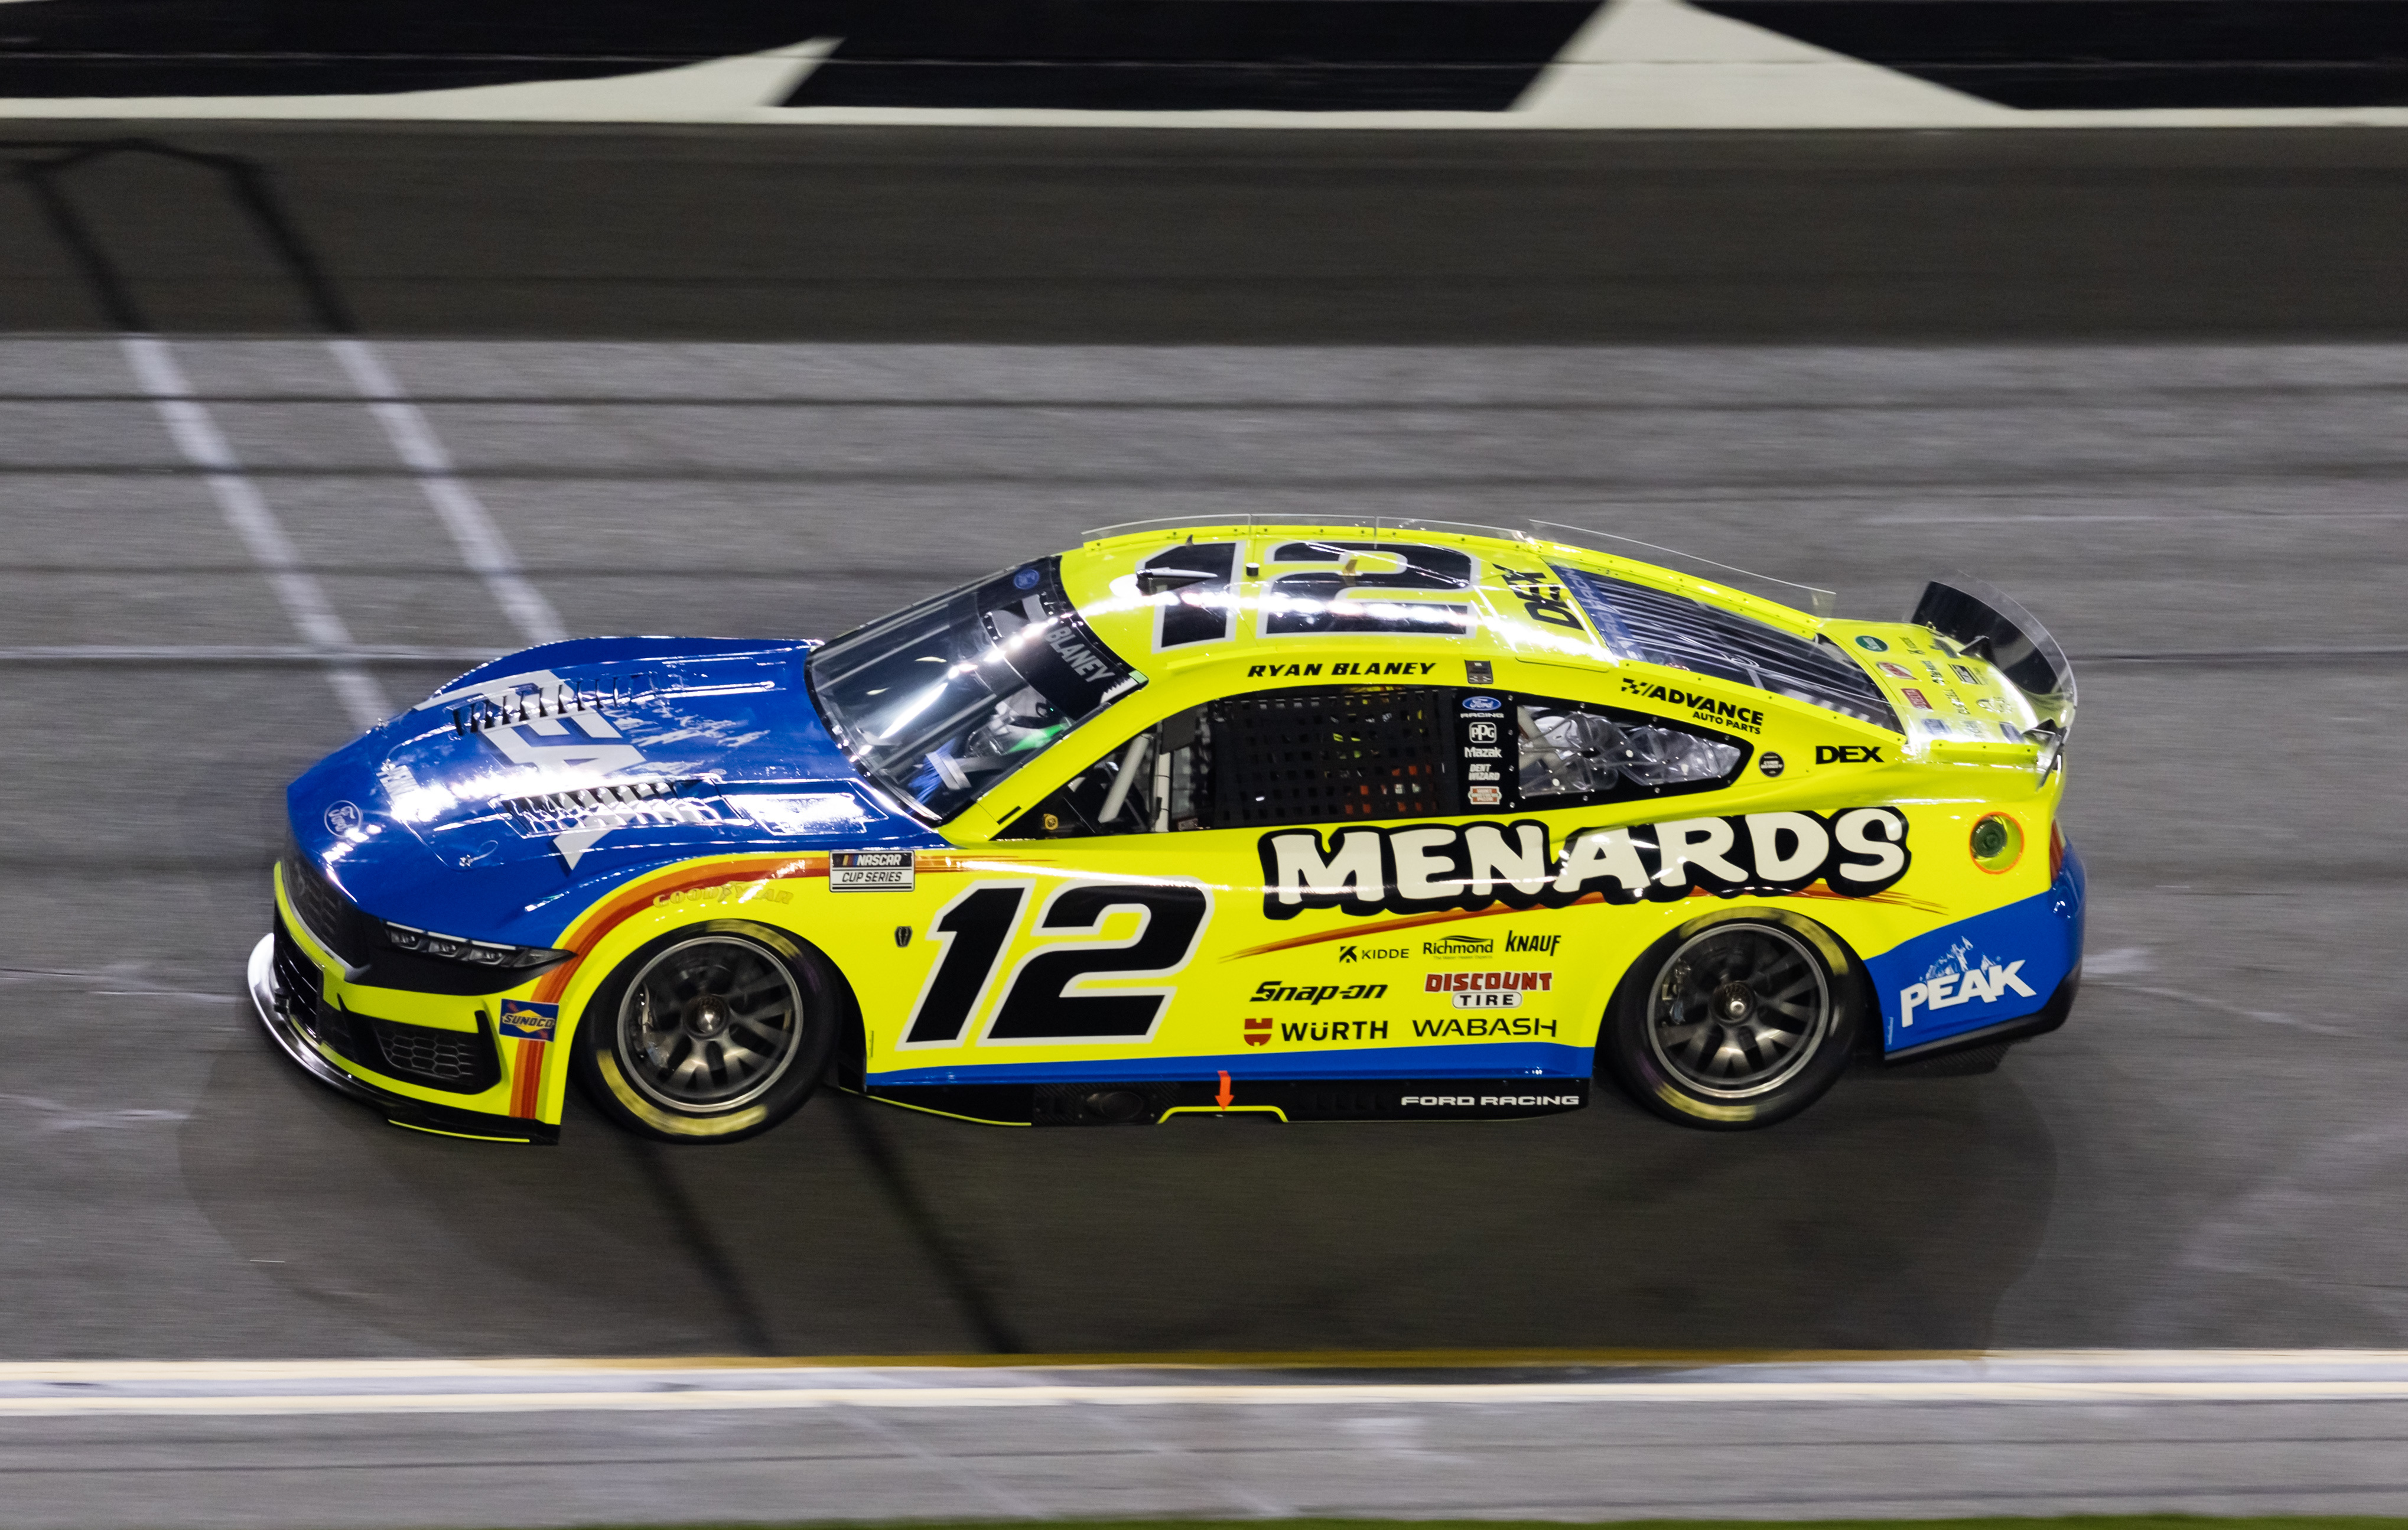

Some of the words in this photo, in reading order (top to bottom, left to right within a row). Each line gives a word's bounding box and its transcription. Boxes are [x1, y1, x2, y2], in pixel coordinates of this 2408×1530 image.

[1135, 541, 1480, 653] 12
[1045, 627, 1116, 683] BLANEY
[1247, 663, 1322, 678] RYAN
[1331, 662, 1436, 675] BLANEY
[1469, 698, 1494, 709] Ford
[1648, 686, 1763, 726] ADVANCE
[1693, 711, 1723, 724] AUTO
[1726, 720, 1761, 735] PARTS
[1471, 724, 1495, 741] PPG
[1464, 747, 1503, 758] Mazak
[1815, 746, 1885, 764] DEX
[856, 854, 902, 866] NASCAR
[1258, 806, 1911, 920] MENARDS
[842, 872, 863, 883] CUP
[864, 871, 902, 882] SERIES
[653, 881, 793, 908] GOODYAR
[1423, 939, 1493, 954] Richmond
[1505, 930, 1561, 956] KNAUF
[896, 875, 1215, 1050] 12
[1361, 948, 1410, 959] KIDDE
[1424, 972, 1552, 992] DISCOUNT
[1249, 981, 1388, 1005] Snap-on
[1460, 994, 1514, 1006] TIRE
[1900, 959, 2038, 1028] PEAK
[503, 1014, 555, 1028] SUNOCO
[1412, 1018, 1557, 1037] WABASH
[1401, 1096, 1475, 1106] FORD
[1480, 1096, 1579, 1105] RACING
